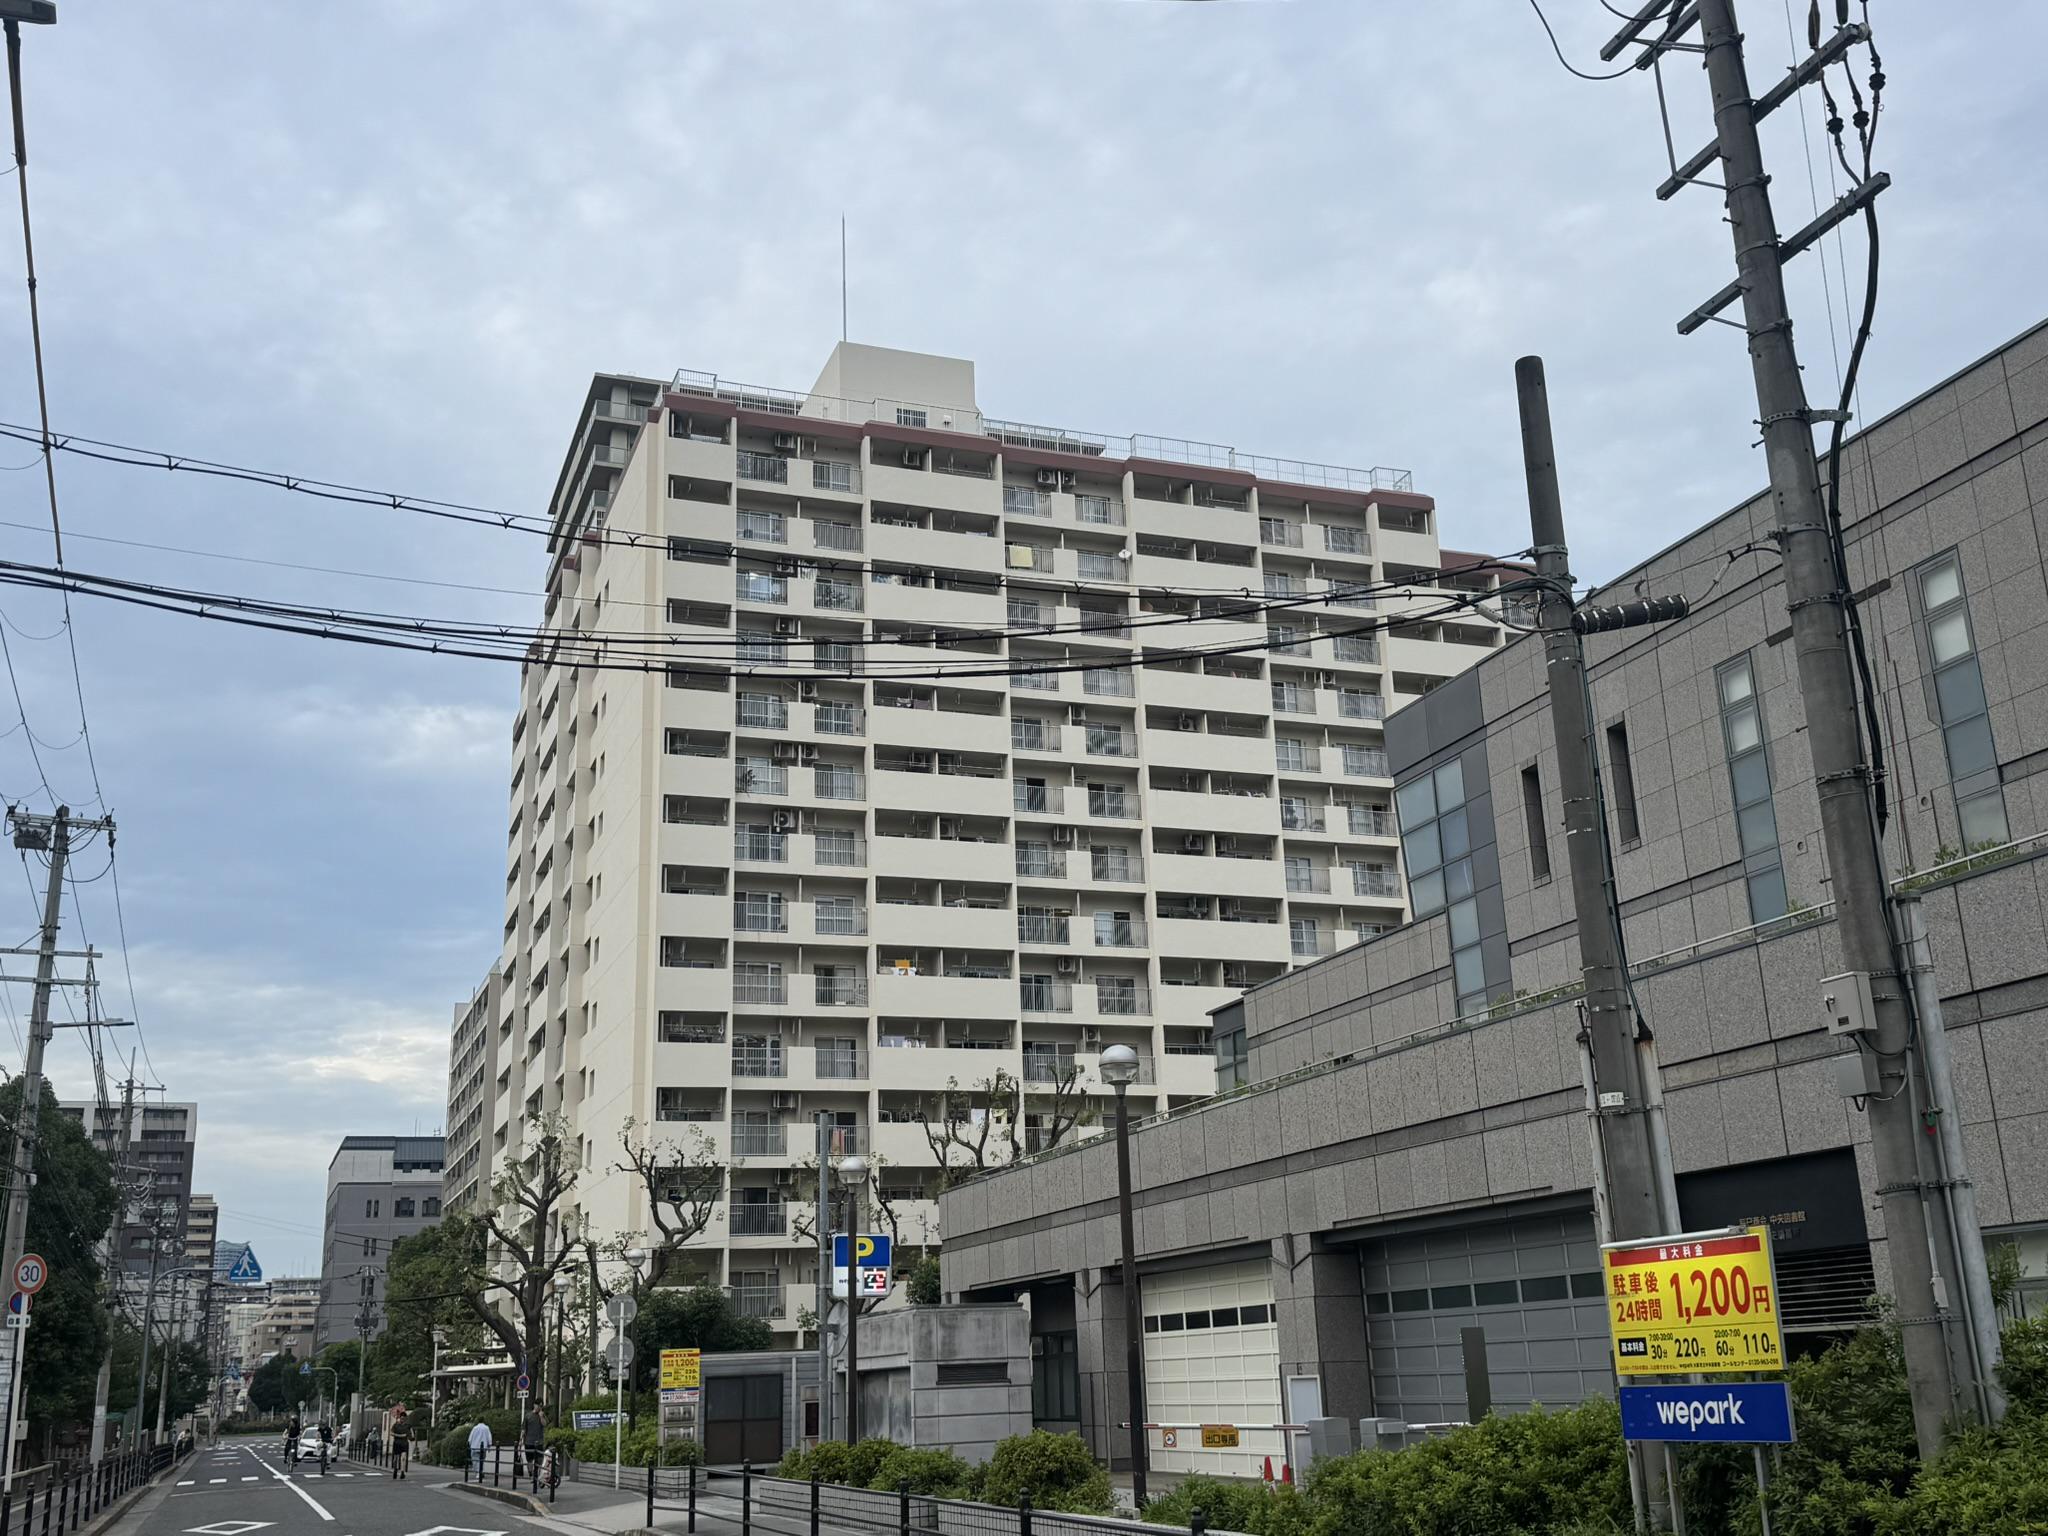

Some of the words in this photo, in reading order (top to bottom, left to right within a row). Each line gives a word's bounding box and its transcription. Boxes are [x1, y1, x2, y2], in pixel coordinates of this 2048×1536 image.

[856, 1237, 875, 1265] P
[1660, 1244, 1704, 1260] 最大料金
[21, 1265, 39, 1282] 30
[864, 1268, 887, 1292] 空
[1612, 1271, 1659, 1296] 駐車後
[1669, 1265, 1771, 1324] 1,200円
[1616, 1298, 1662, 1323] 24時間
[1620, 1341, 1645, 1353] 基本料金
[1650, 1344, 1668, 1360] 30分
[1674, 1336, 1707, 1358] 220円
[1716, 1340, 1735, 1356] 60分
[1743, 1332, 1777, 1355] 110円
[1656, 1393, 1745, 1432] wepark
